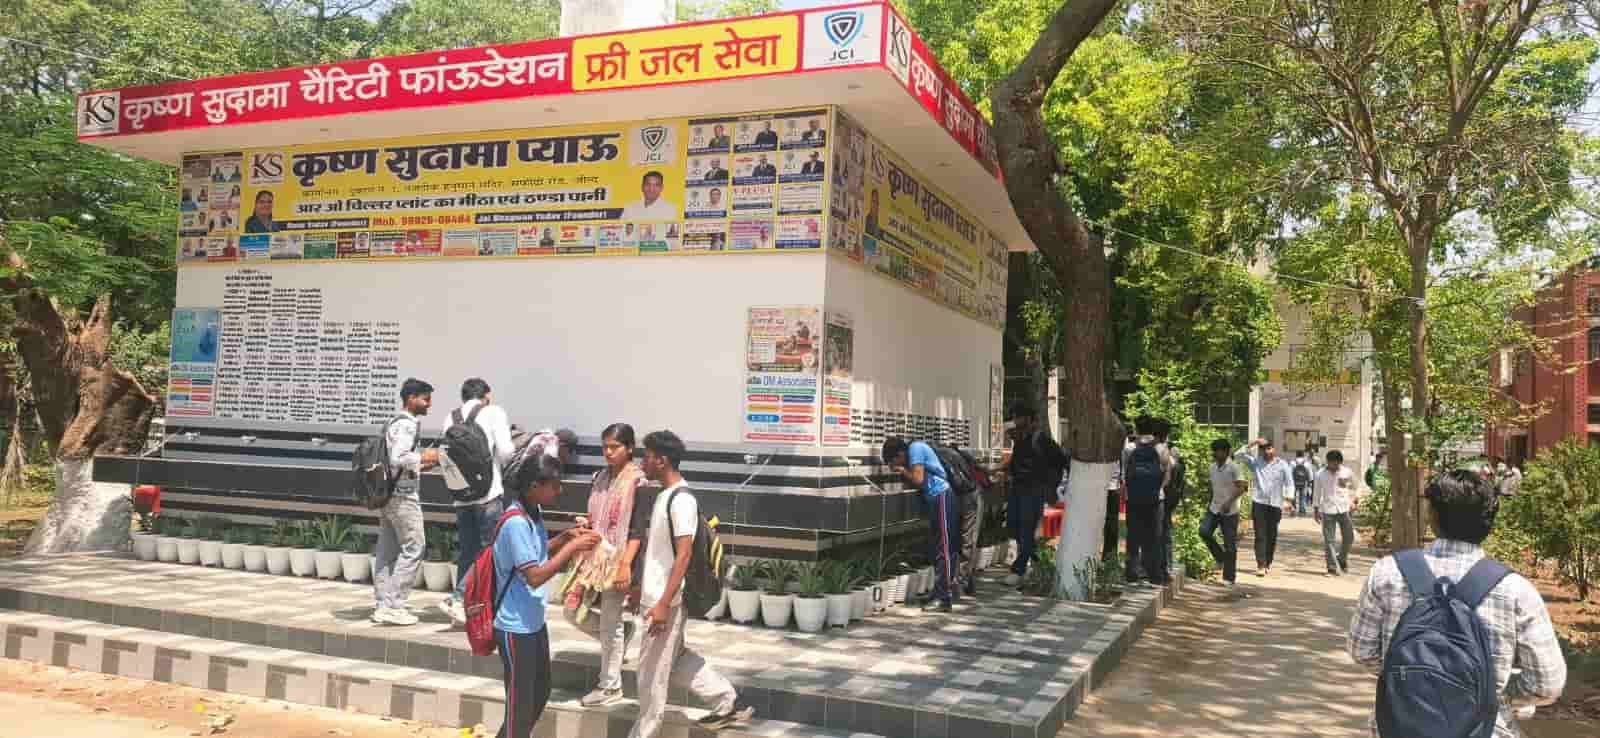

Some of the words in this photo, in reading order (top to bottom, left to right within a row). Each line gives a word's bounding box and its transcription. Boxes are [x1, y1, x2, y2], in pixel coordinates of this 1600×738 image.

[585, 40, 631, 84] फ्री
[639, 43, 702, 79] जल
[714, 28, 781, 69] सेवा
[829, 47, 854, 61] JCI
[890, 15, 909, 68] KS
[123, 92, 191, 129] कृष्ण
[200, 81, 290, 123] सुदामा
[299, 64, 390, 105] चैरिटी
[398, 48, 569, 95] फांऊडेशन
[911, 49, 943, 109] कृष्ण
[83, 94, 115, 125] KS
[251, 152, 283, 178] KS
[292, 149, 379, 187] कृष्ण
[384, 140, 511, 181] सुदामा
[515, 132, 621, 165] प्याऊ
[644, 151, 662, 162] JCI
[296, 202, 322, 214] आर
[345, 198, 393, 212] चिल्लर
[396, 196, 431, 209] प्लांट
[433, 197, 456, 208] का
[459, 192, 496, 207] मीठा
[497, 191, 521, 205] एवं
[524, 190, 566, 205] ठण्डा
[567, 187, 607, 202] पानी
[887, 160, 919, 206] कृष्ण
